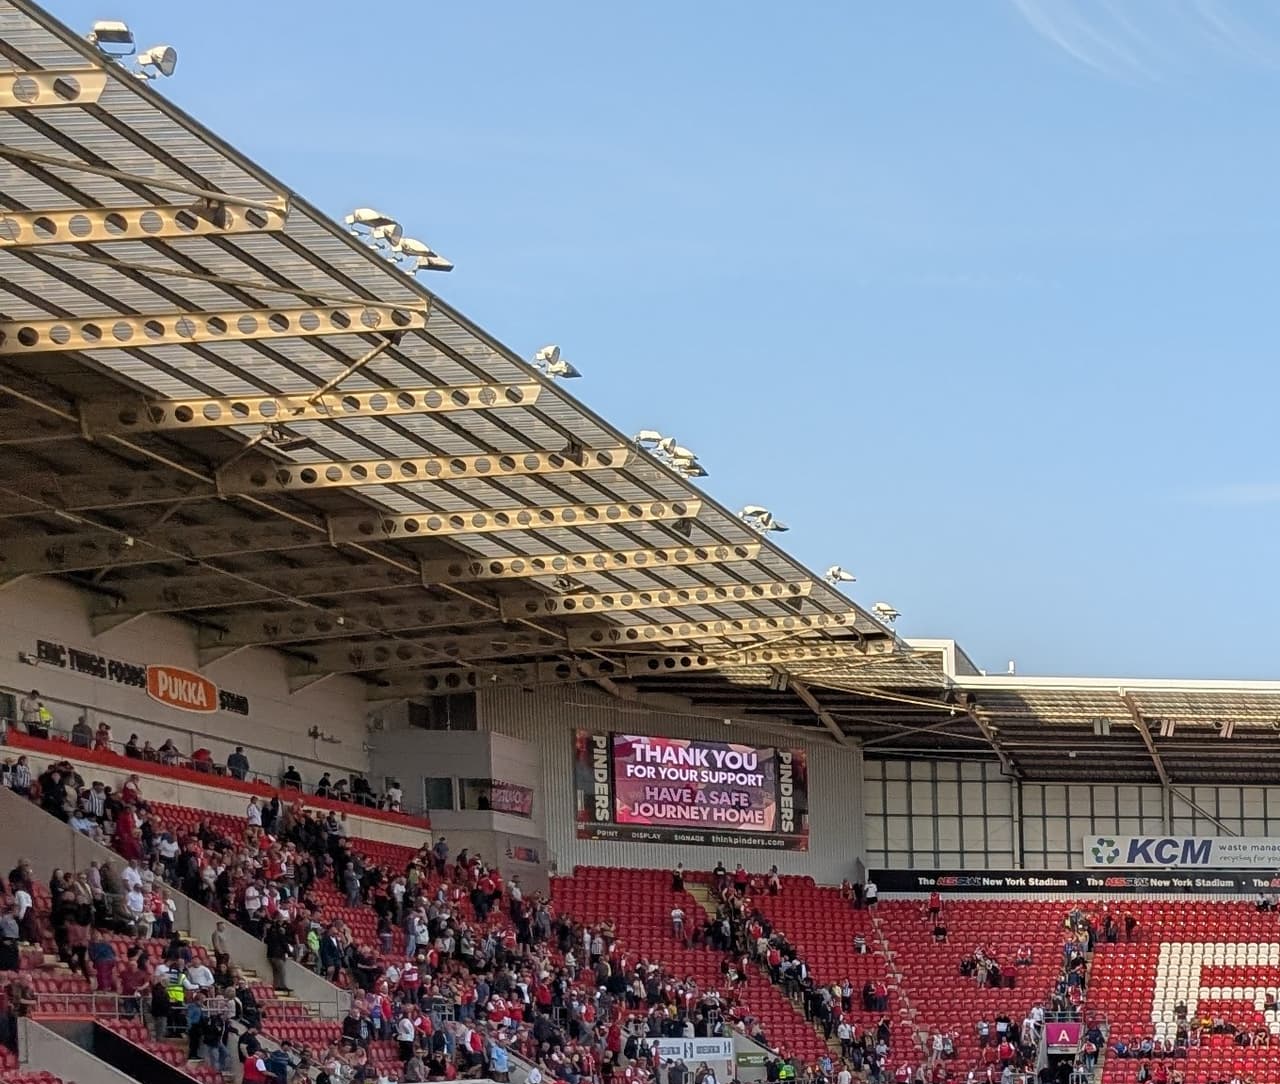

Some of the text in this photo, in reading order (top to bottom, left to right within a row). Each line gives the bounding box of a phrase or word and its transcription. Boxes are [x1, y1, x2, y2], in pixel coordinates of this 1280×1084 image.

[158, 670, 208, 707] PUKKA
[632, 743, 758, 771] THANK YOU
[592, 735, 610, 822] PINDERS
[626, 765, 764, 787] FOR YOUR SUPPORT
[645, 786, 749, 807] HAVE A SAFE
[778, 751, 794, 833] PINDERS
[631, 803, 765, 824] JOURNEY HOME
[631, 832, 661, 840] DISPLAY
[674, 834, 705, 842] SIGNAGE
[712, 835, 784, 847] thinkpinders.com
[1127, 839, 1212, 865] KCM
[1219, 844, 1247, 852] waste
[918, 877, 935, 887] The
[982, 877, 1003, 887] New
[1005, 877, 1026, 887] York
[1028, 877, 1067, 887] Stadium
[1086, 878, 1104, 887] The
[1150, 878, 1170, 887] New
[1172, 878, 1193, 887] York
[1195, 878, 1234, 887] Stadium
[1252, 879, 1269, 888] The
[1058, 1030, 1069, 1042] A
